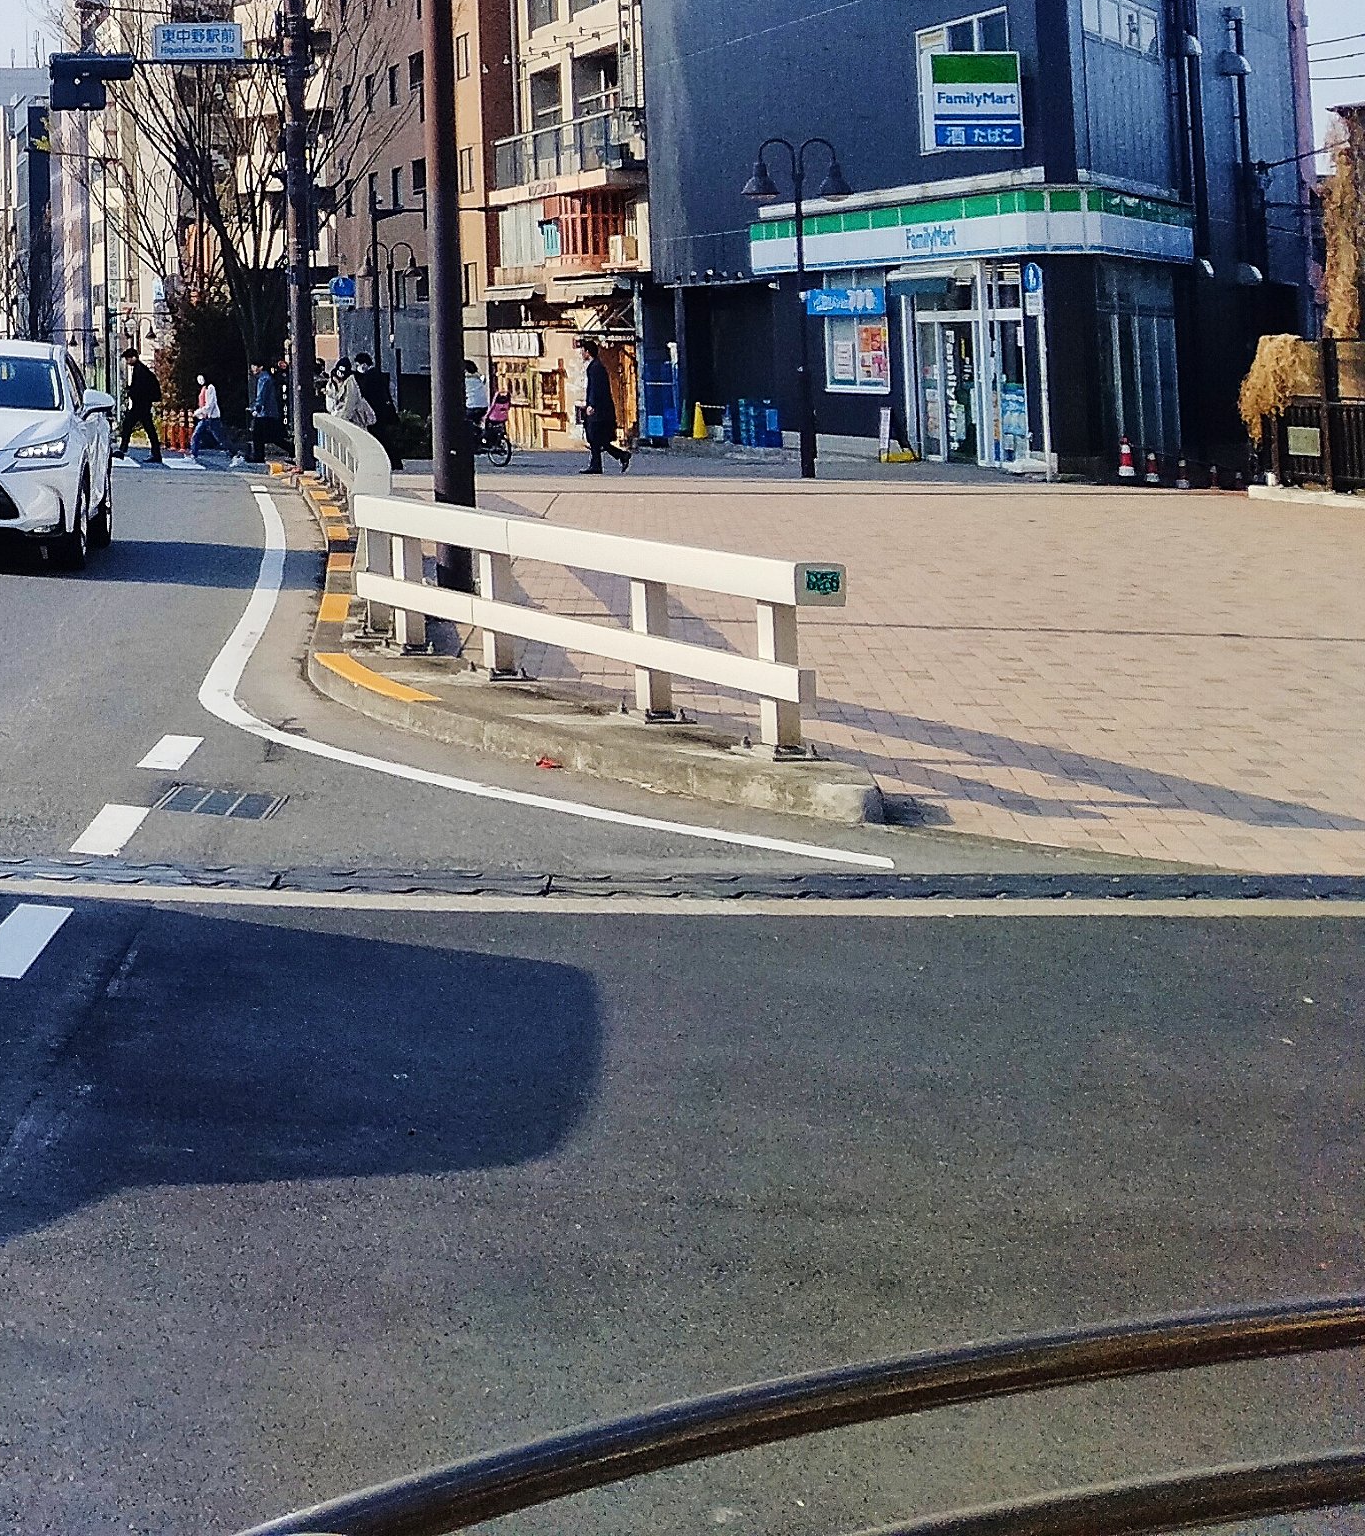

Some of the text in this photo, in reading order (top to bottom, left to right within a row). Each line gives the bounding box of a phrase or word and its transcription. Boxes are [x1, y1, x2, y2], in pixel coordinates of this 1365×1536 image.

[161, 28, 235, 44] 東中野駅前
[937, 92, 1015, 107] FamilyMart
[945, 126, 1015, 145] 酒 たばこ
[906, 225, 957, 252] FamilyMart
